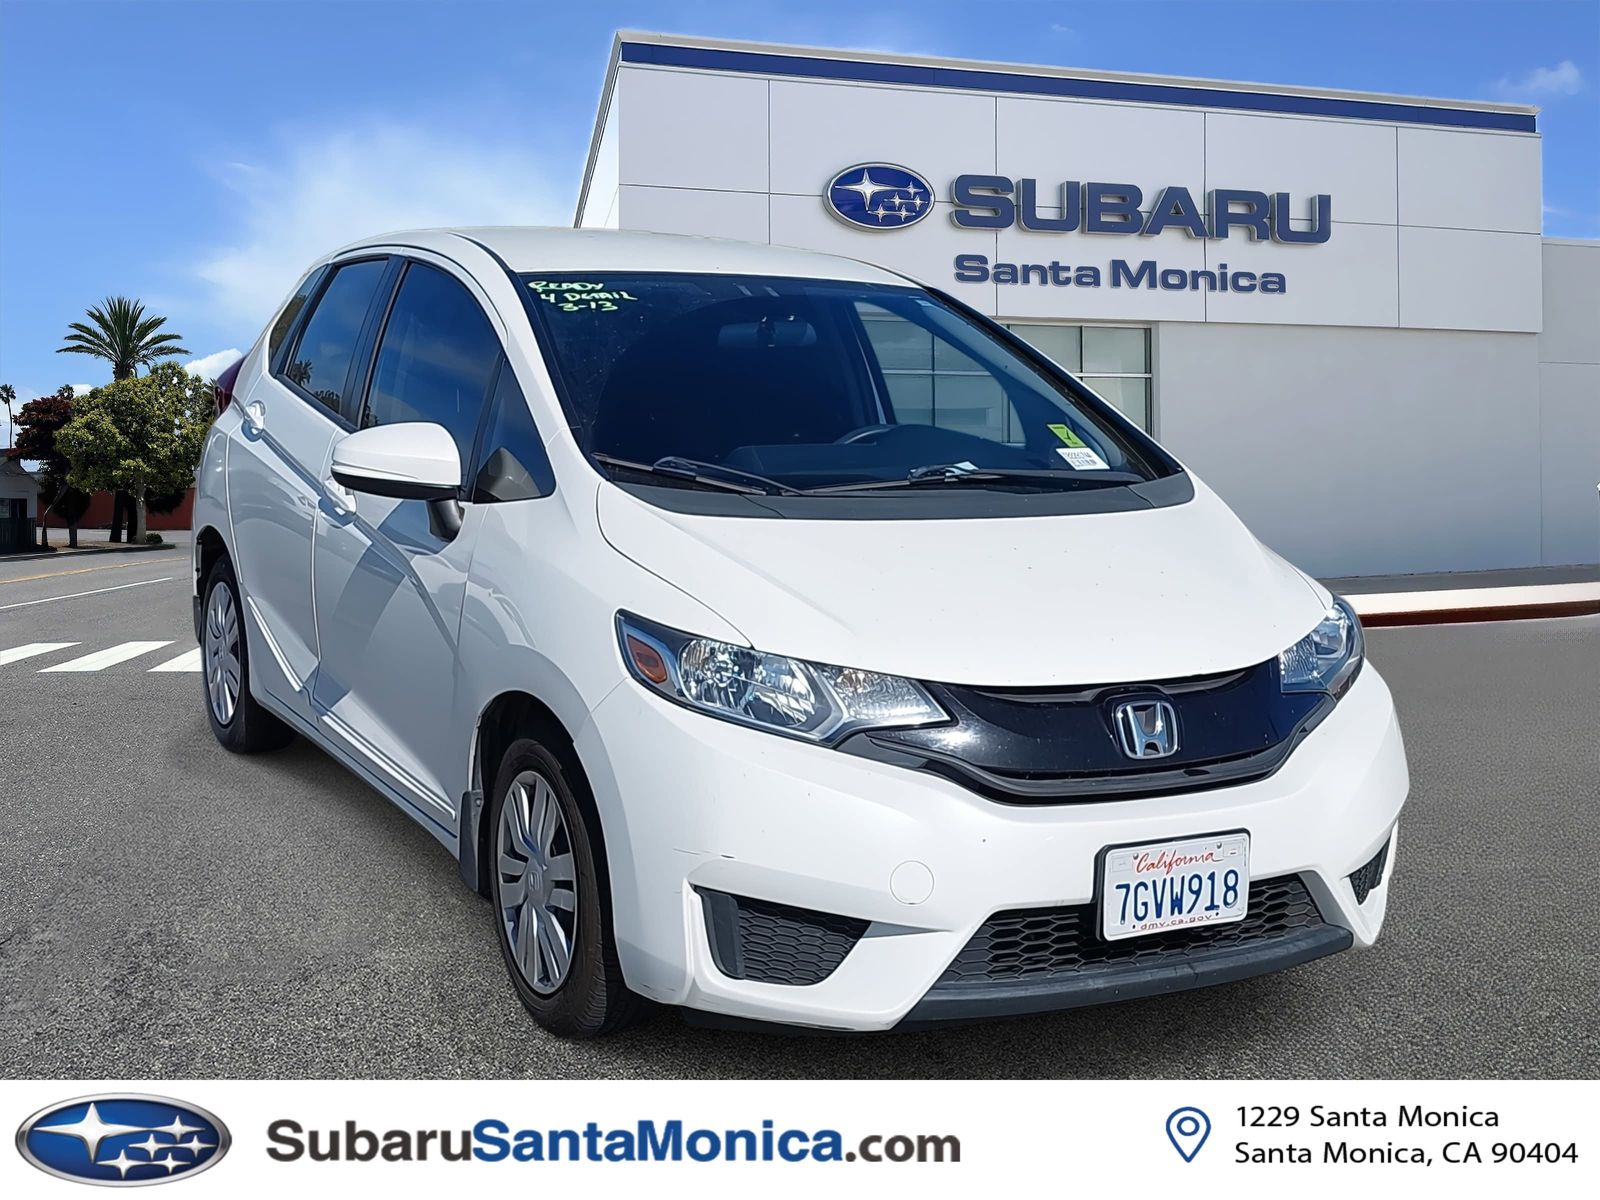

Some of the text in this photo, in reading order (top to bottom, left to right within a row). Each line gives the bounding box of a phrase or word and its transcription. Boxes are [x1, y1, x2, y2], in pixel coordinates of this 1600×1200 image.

[951, 174, 1332, 244] SUBARU
[954, 253, 1287, 294] Santa Monica
[558, 301, 618, 311] 3-13
[1136, 850, 1224, 875] California
[1115, 869, 1239, 925] 7GVW918
[1141, 914, 1213, 930] dmv.ca.gov
